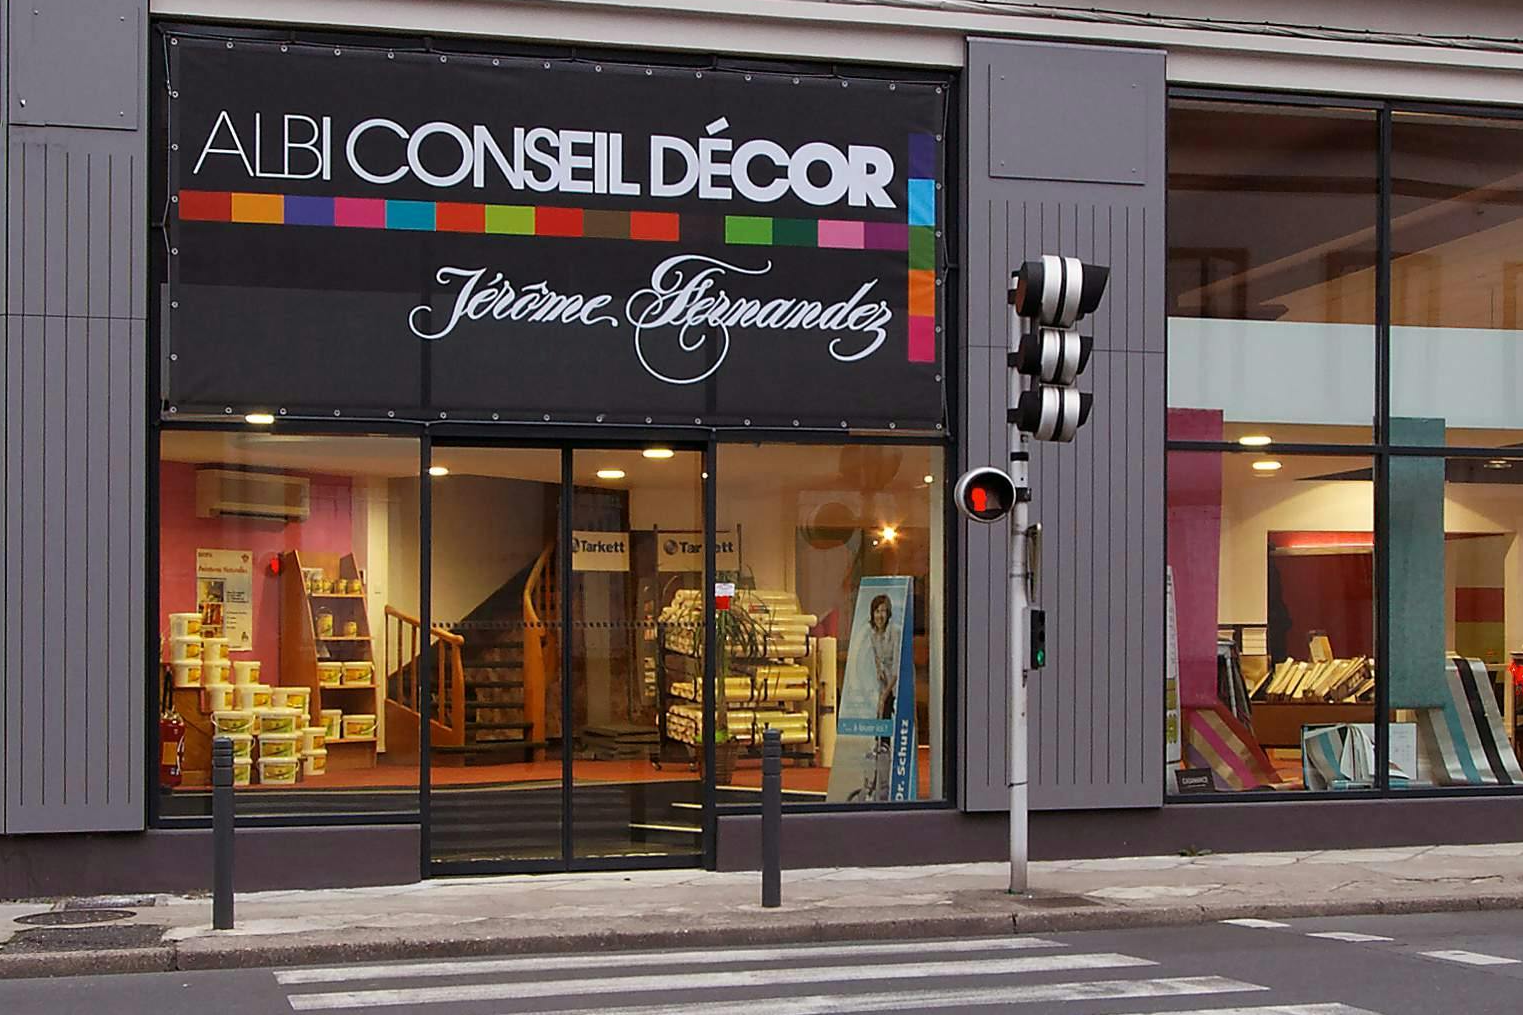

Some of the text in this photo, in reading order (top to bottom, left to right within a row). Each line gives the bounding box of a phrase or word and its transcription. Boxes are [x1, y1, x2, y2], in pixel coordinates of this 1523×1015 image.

[192, 110, 897, 209] ALBI CONSEIL DÉCOR
[408, 254, 894, 384] Jérôme Fernandez
[579, 540, 625, 553] Tarkett
[679, 541, 734, 554] Tarett
[896, 719, 909, 776] Schutz
